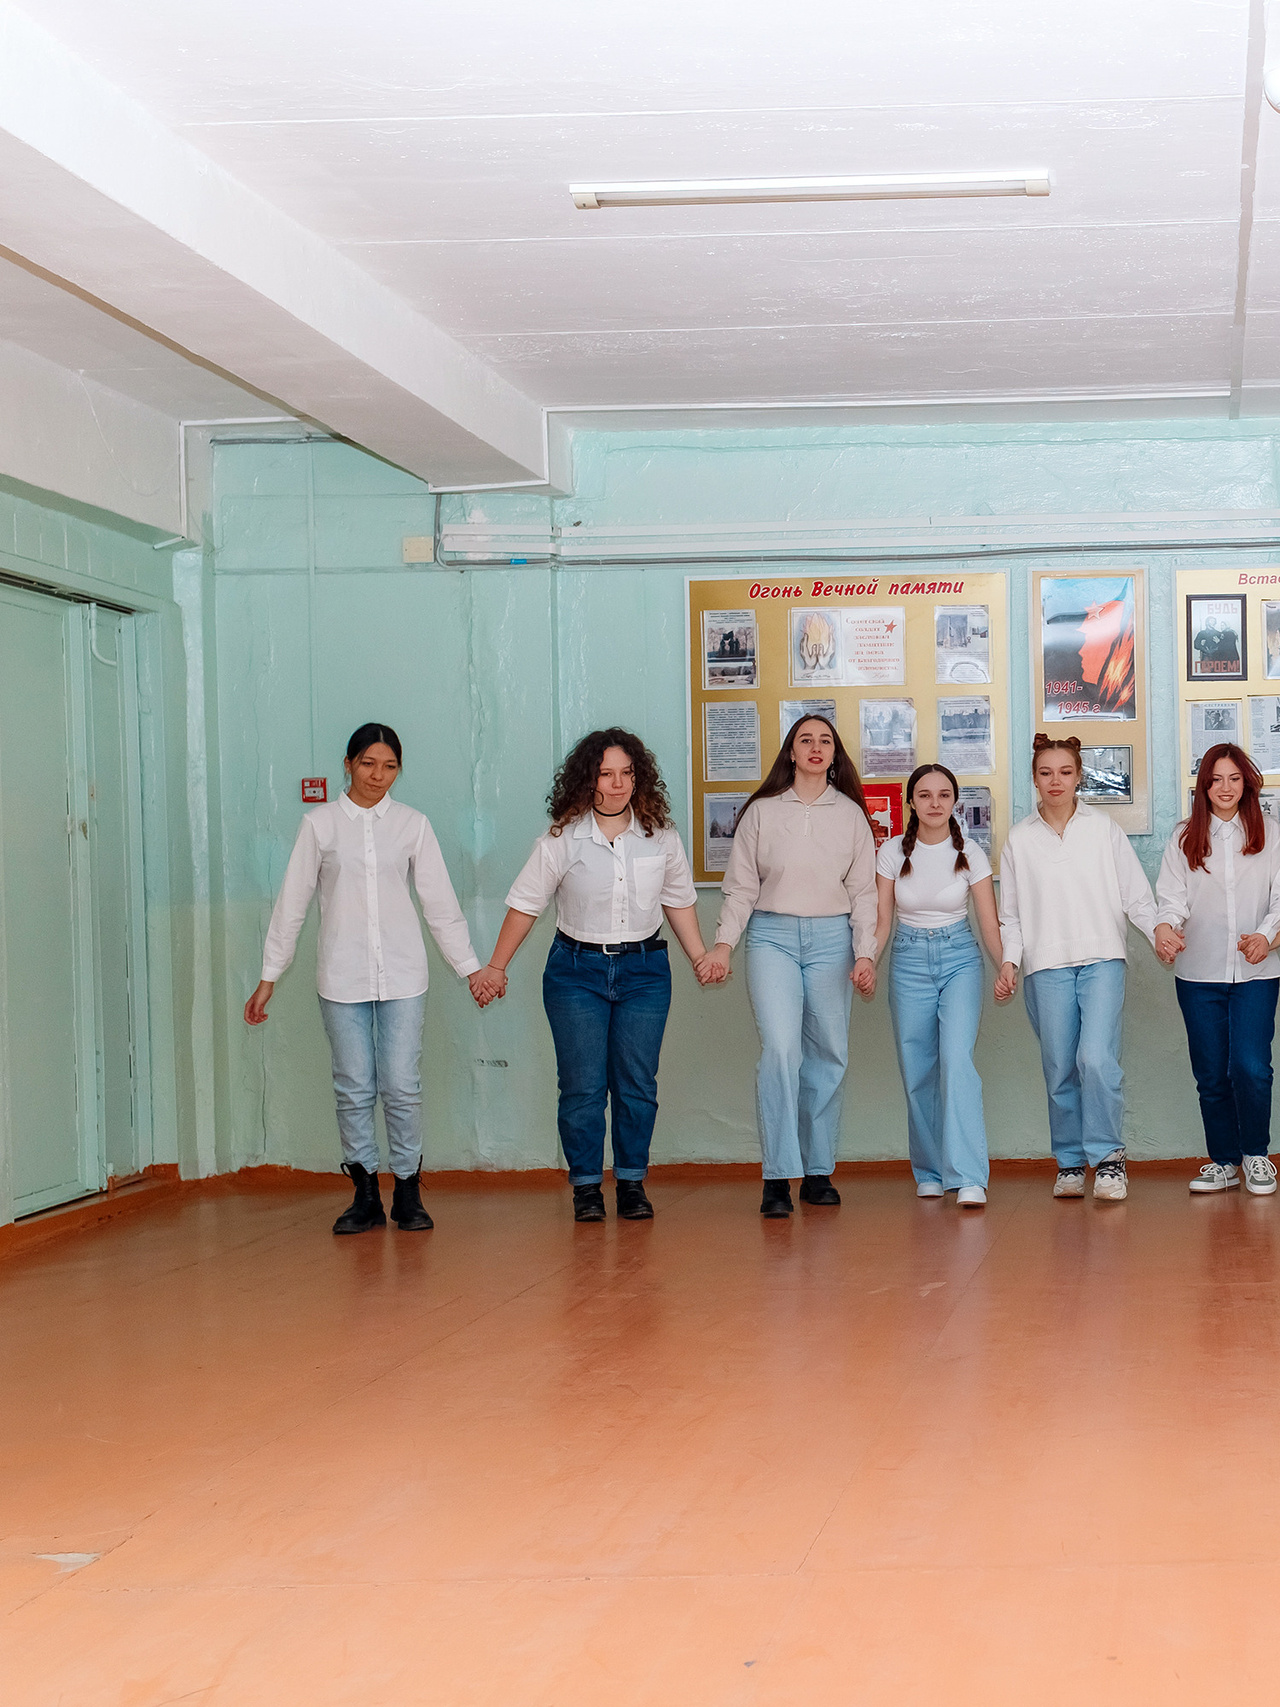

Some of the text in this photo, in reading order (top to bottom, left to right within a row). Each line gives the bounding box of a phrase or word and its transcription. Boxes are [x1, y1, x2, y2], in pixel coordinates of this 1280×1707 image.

[749, 578, 965, 599] Огонь Вечной памяти
[1207, 603, 1238, 614] БУДЬ
[1045, 681, 1083, 694] 1941-
[1057, 701, 1090, 714] 1945
